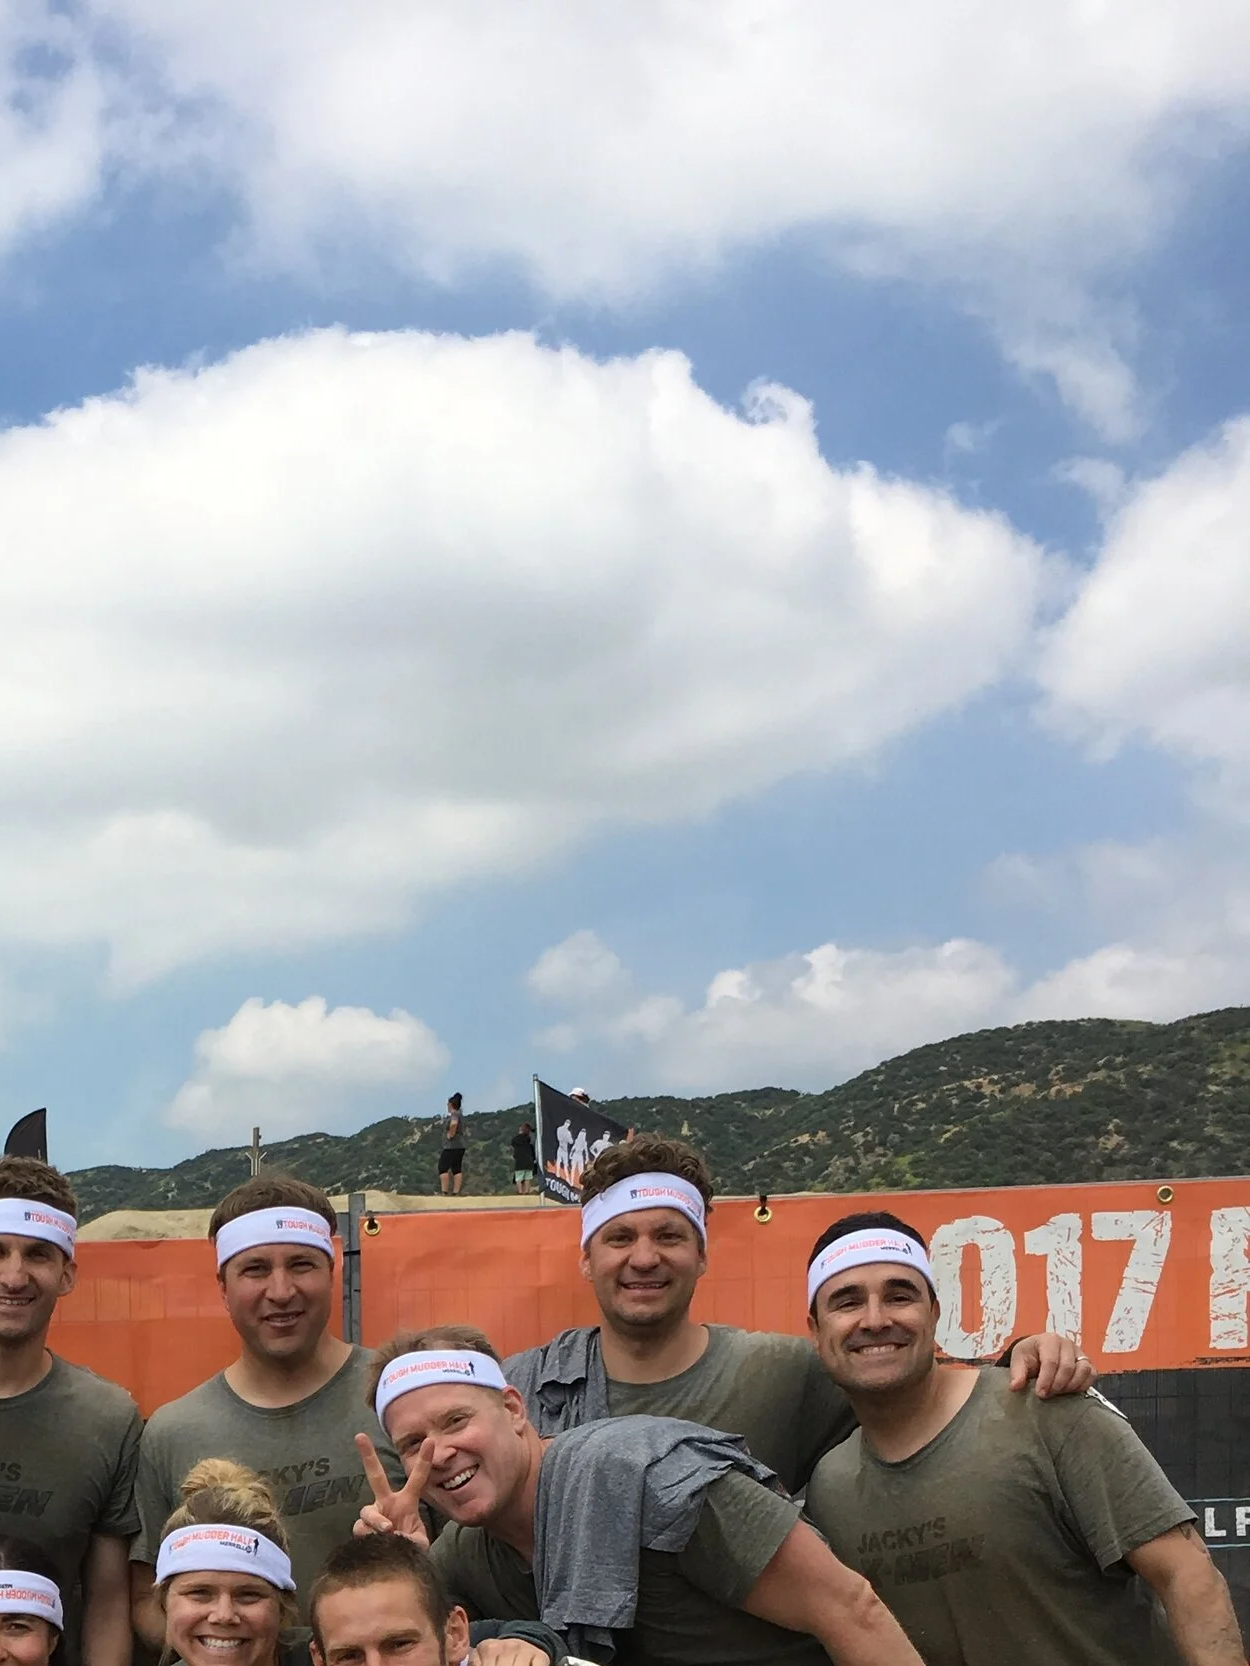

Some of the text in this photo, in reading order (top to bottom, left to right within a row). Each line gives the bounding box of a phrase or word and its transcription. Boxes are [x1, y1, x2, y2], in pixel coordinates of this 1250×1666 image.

[638, 1188, 666, 1198] TOUGH
[848, 1239, 887, 1251] MUDDER
[411, 1361, 448, 1373] MUDDER
[192, 1530, 230, 1541] MUDDER
[231, 1534, 255, 1545] HALF
[858, 1517, 946, 1553] JACKY'S
